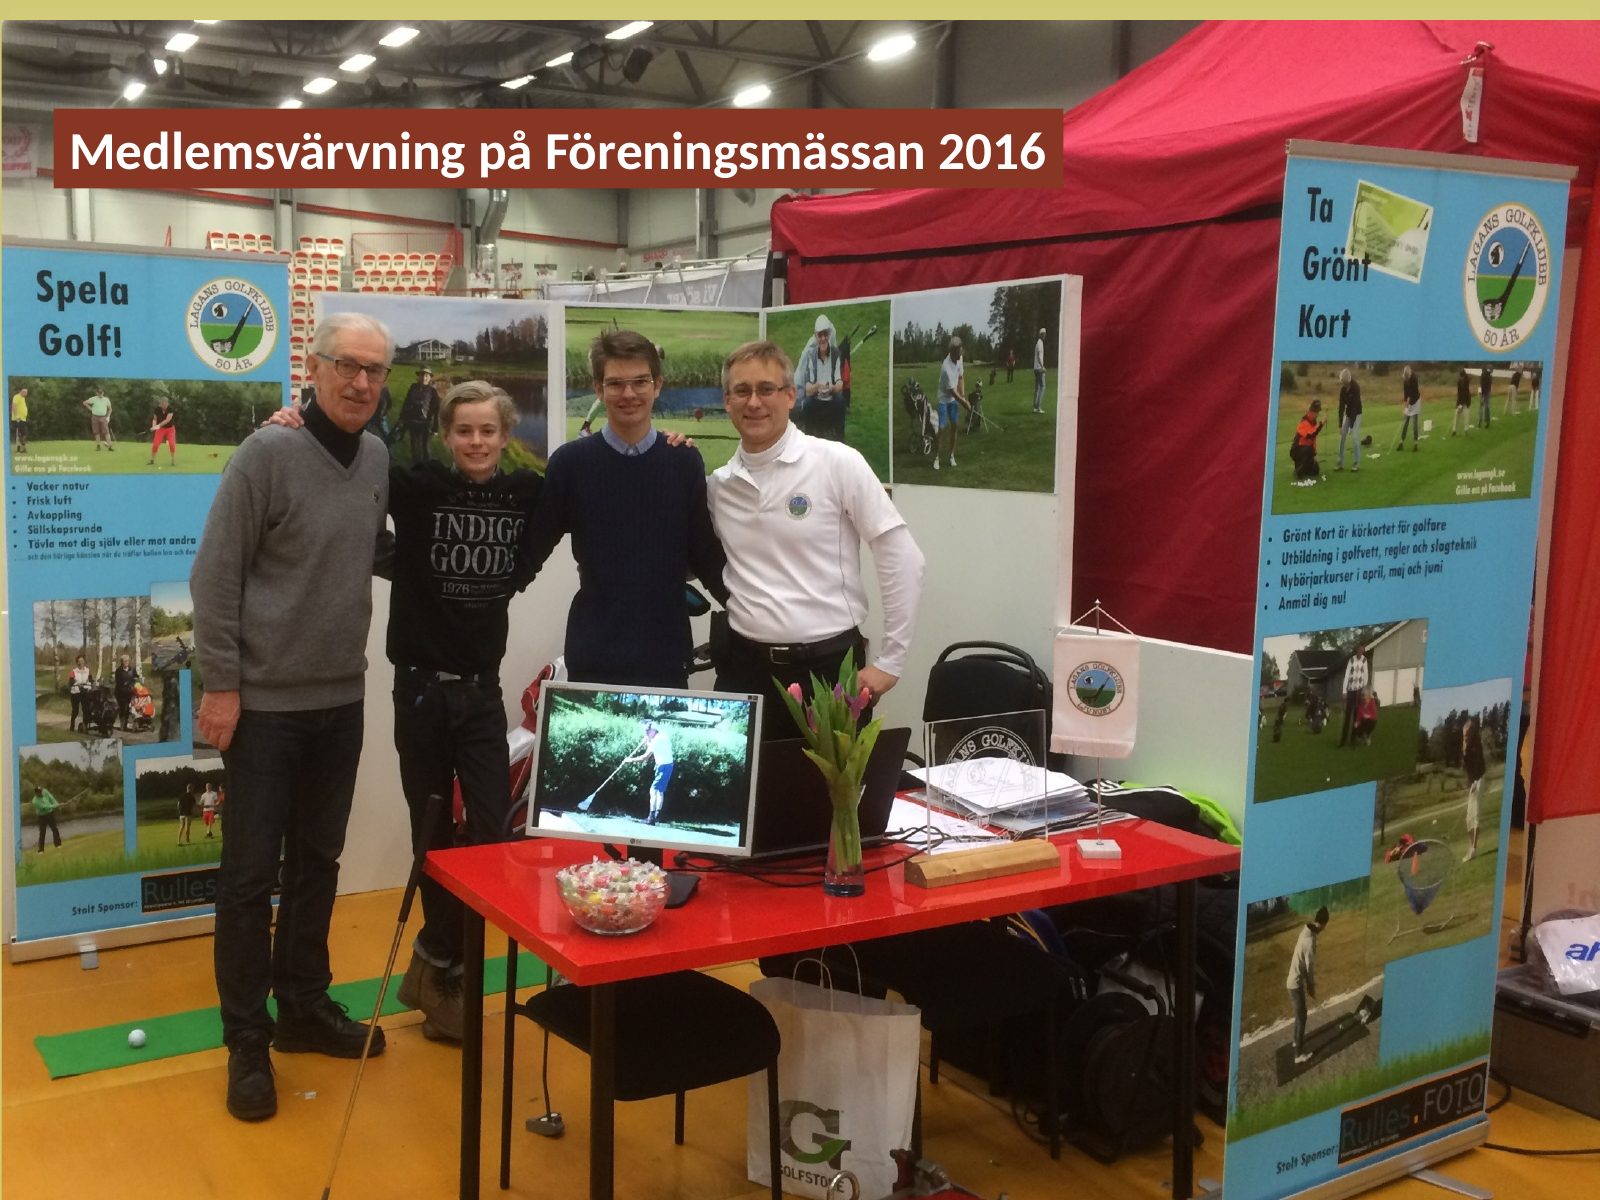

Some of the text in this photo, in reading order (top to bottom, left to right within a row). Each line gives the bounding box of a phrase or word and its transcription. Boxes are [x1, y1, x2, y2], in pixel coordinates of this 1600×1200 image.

[1308, 187, 1333, 223] Ta
[1468, 209, 1547, 286] LAGANS GOLFKLUBB
[1303, 245, 1371, 281] Grönt
[36, 270, 129, 311] Spela
[189, 280, 274, 332] LAGANS GOLFKLUBB
[1298, 304, 1351, 339] Kort
[39, 323, 121, 358] Golf!
[1483, 328, 1520, 347] 50 ÅR
[215, 357, 252, 371] 50 ÅR
[27, 481, 90, 491] Vacker natur
[27, 496, 72, 506] Frisk luft
[27, 510, 82, 522] Avkoppling
[27, 523, 102, 536] Sällskapsrunda
[1283, 517, 1447, 543] Grönt Kort är körkortet för golfare
[28, 535, 197, 550] Tävla mot dig själv eller mot andra
[1282, 535, 1478, 566] Utbildning i golfvett, regler och slagteknik
[431, 542, 518, 575] GOODS
[442, 582, 470, 594] 1976
[1280, 559, 1444, 591] Nybörjarkurser i april, maj och juni
[1278, 590, 1347, 611] Anmäl dig nu!
[72, 905, 95, 916] Stolt
[97, 900, 138, 914] Sponsor:
[1276, 1158, 1299, 1175] Stolt
[1301, 1144, 1339, 1166] Sponsor:
[780, 1165, 845, 1194] OLFSTOE
